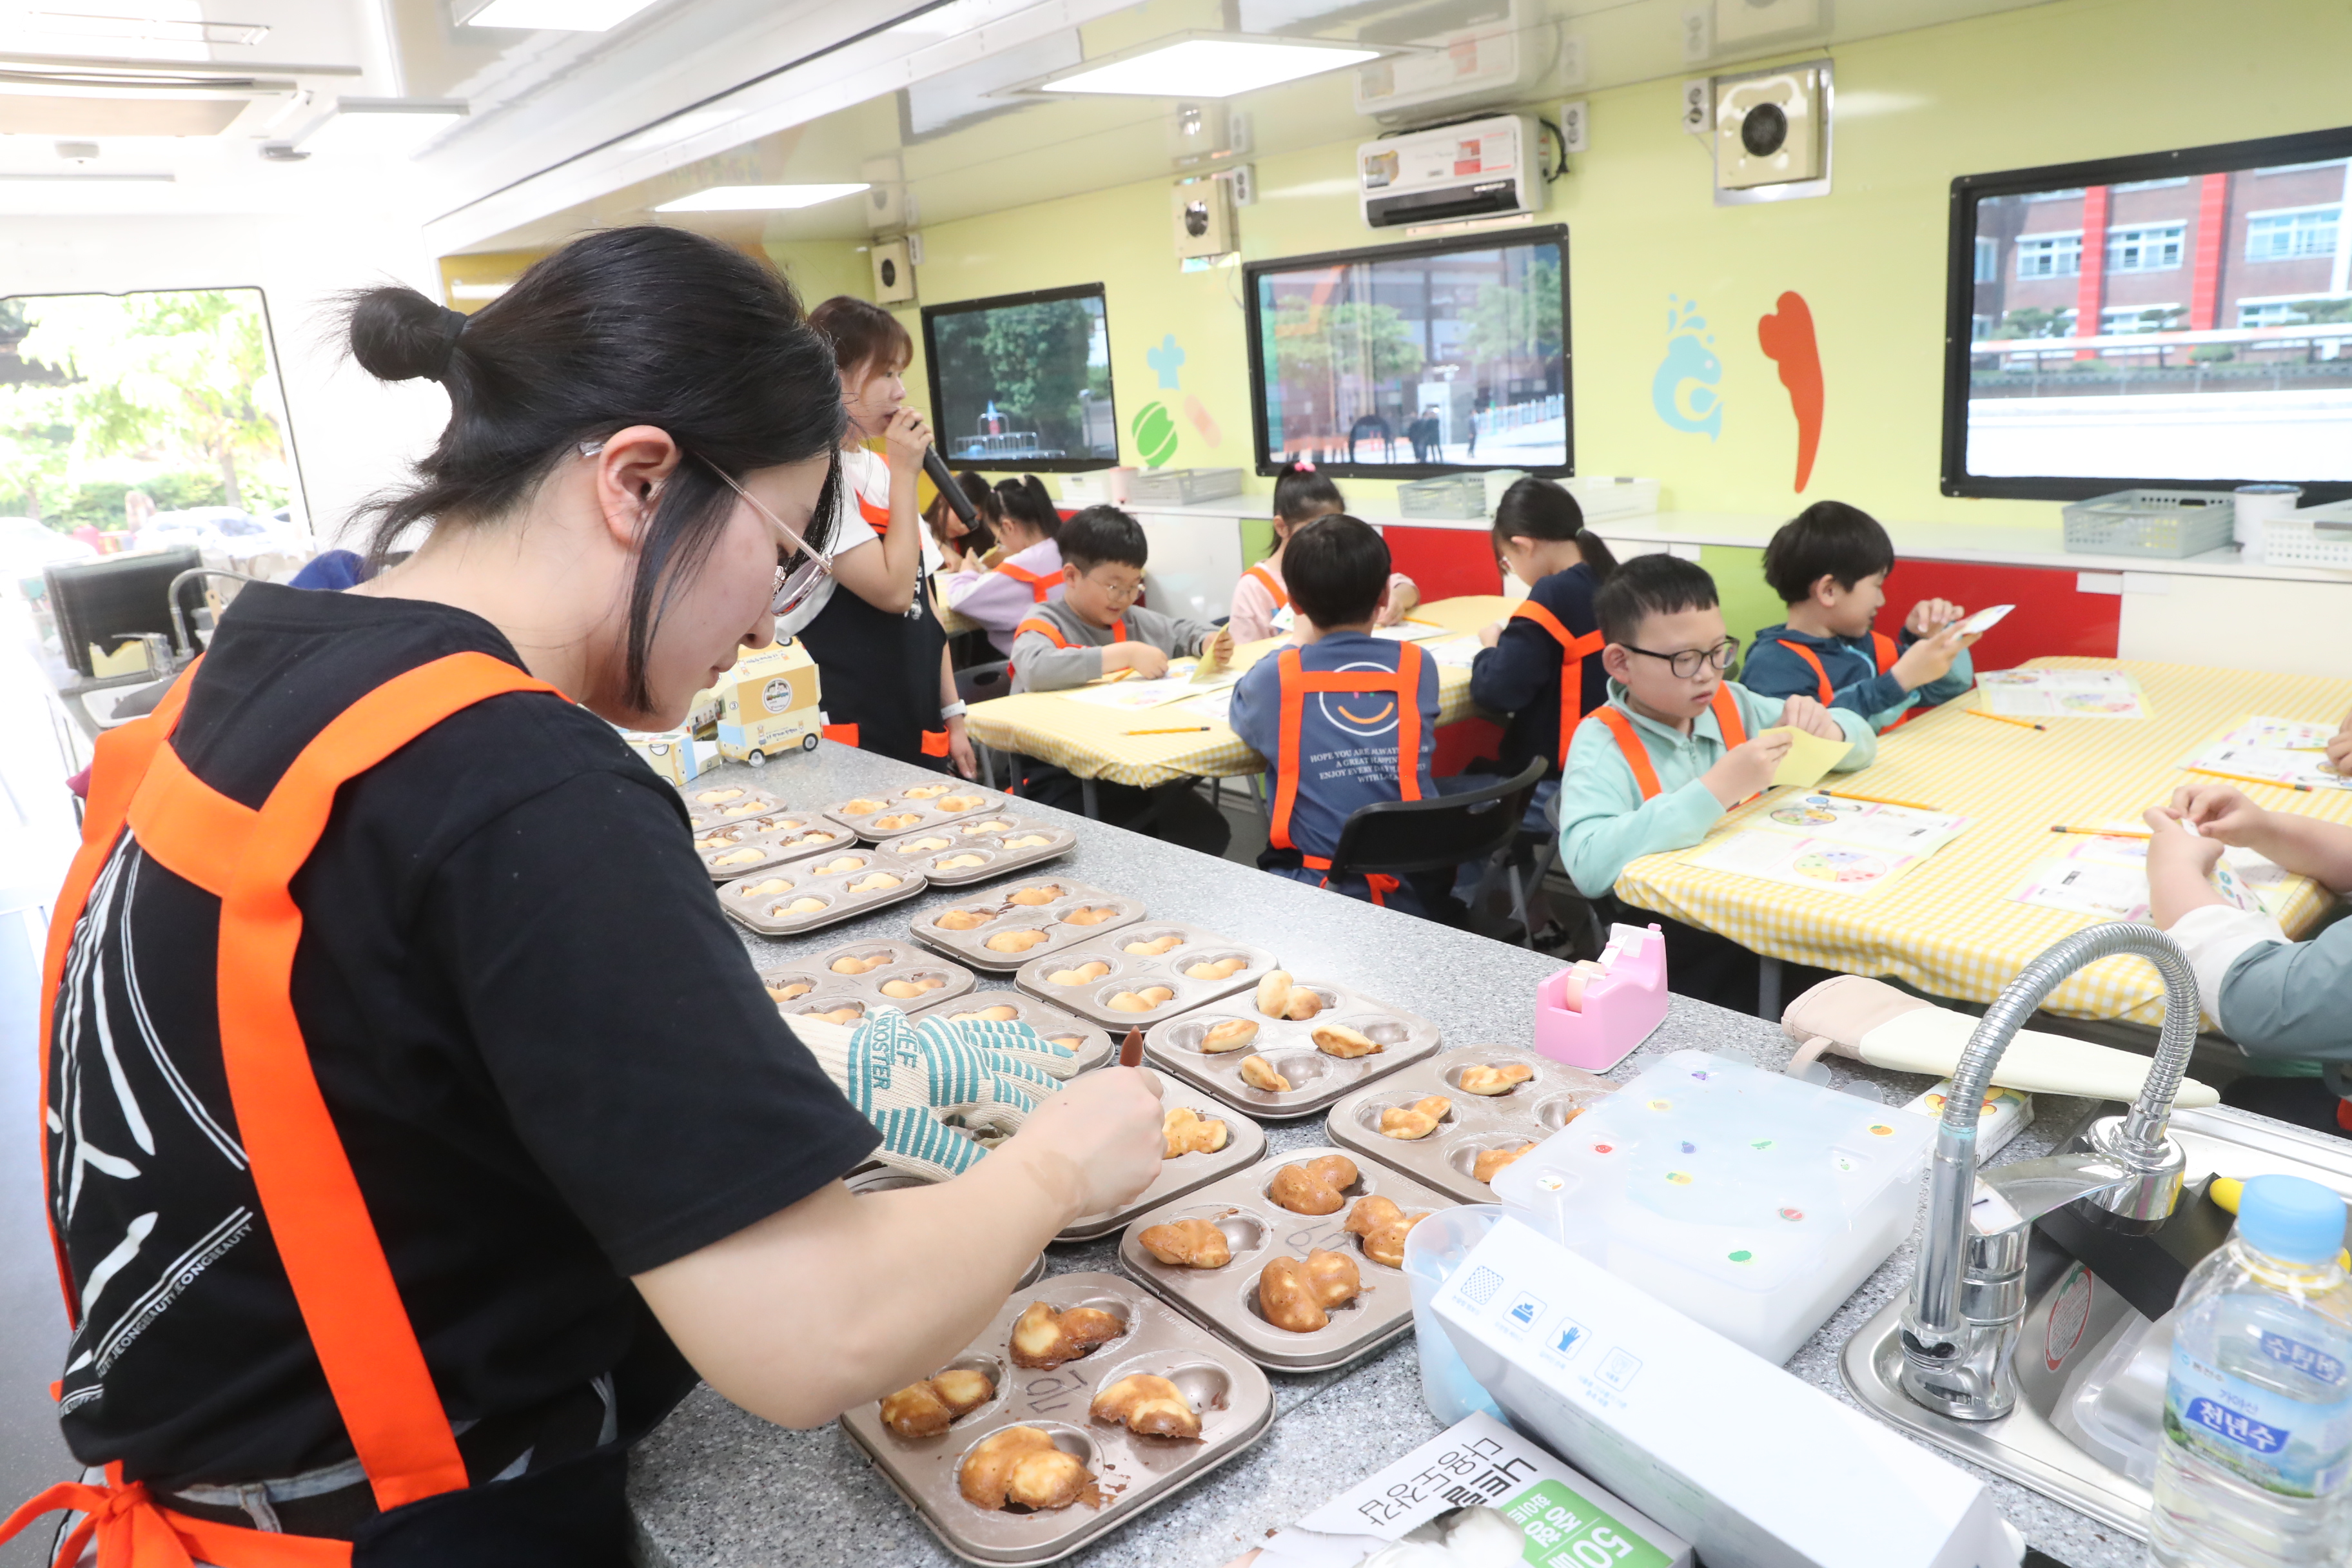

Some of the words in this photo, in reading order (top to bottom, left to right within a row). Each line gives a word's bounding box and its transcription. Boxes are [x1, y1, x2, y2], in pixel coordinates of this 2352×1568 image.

[1309, 753, 1335, 763] HOPE
[1334, 749, 1351, 759] YOU
[1353, 748, 1369, 756] ARE
[1319, 769, 1347, 780] ENJOY
[1348, 765, 1373, 776] EVERY
[1343, 757, 1369, 767] GREAT
[1370, 756, 1398, 765] HAPPIN
[872, 1017, 891, 1089] BOOSTER
[896, 1017, 920, 1068] CHEF
[2199, 1400, 2278, 1451] 천년수
[1358, 1437, 1504, 1526] 다용도장갑
[1507, 1493, 1553, 1524] 화이트
[1524, 1506, 1583, 1549] 중형
